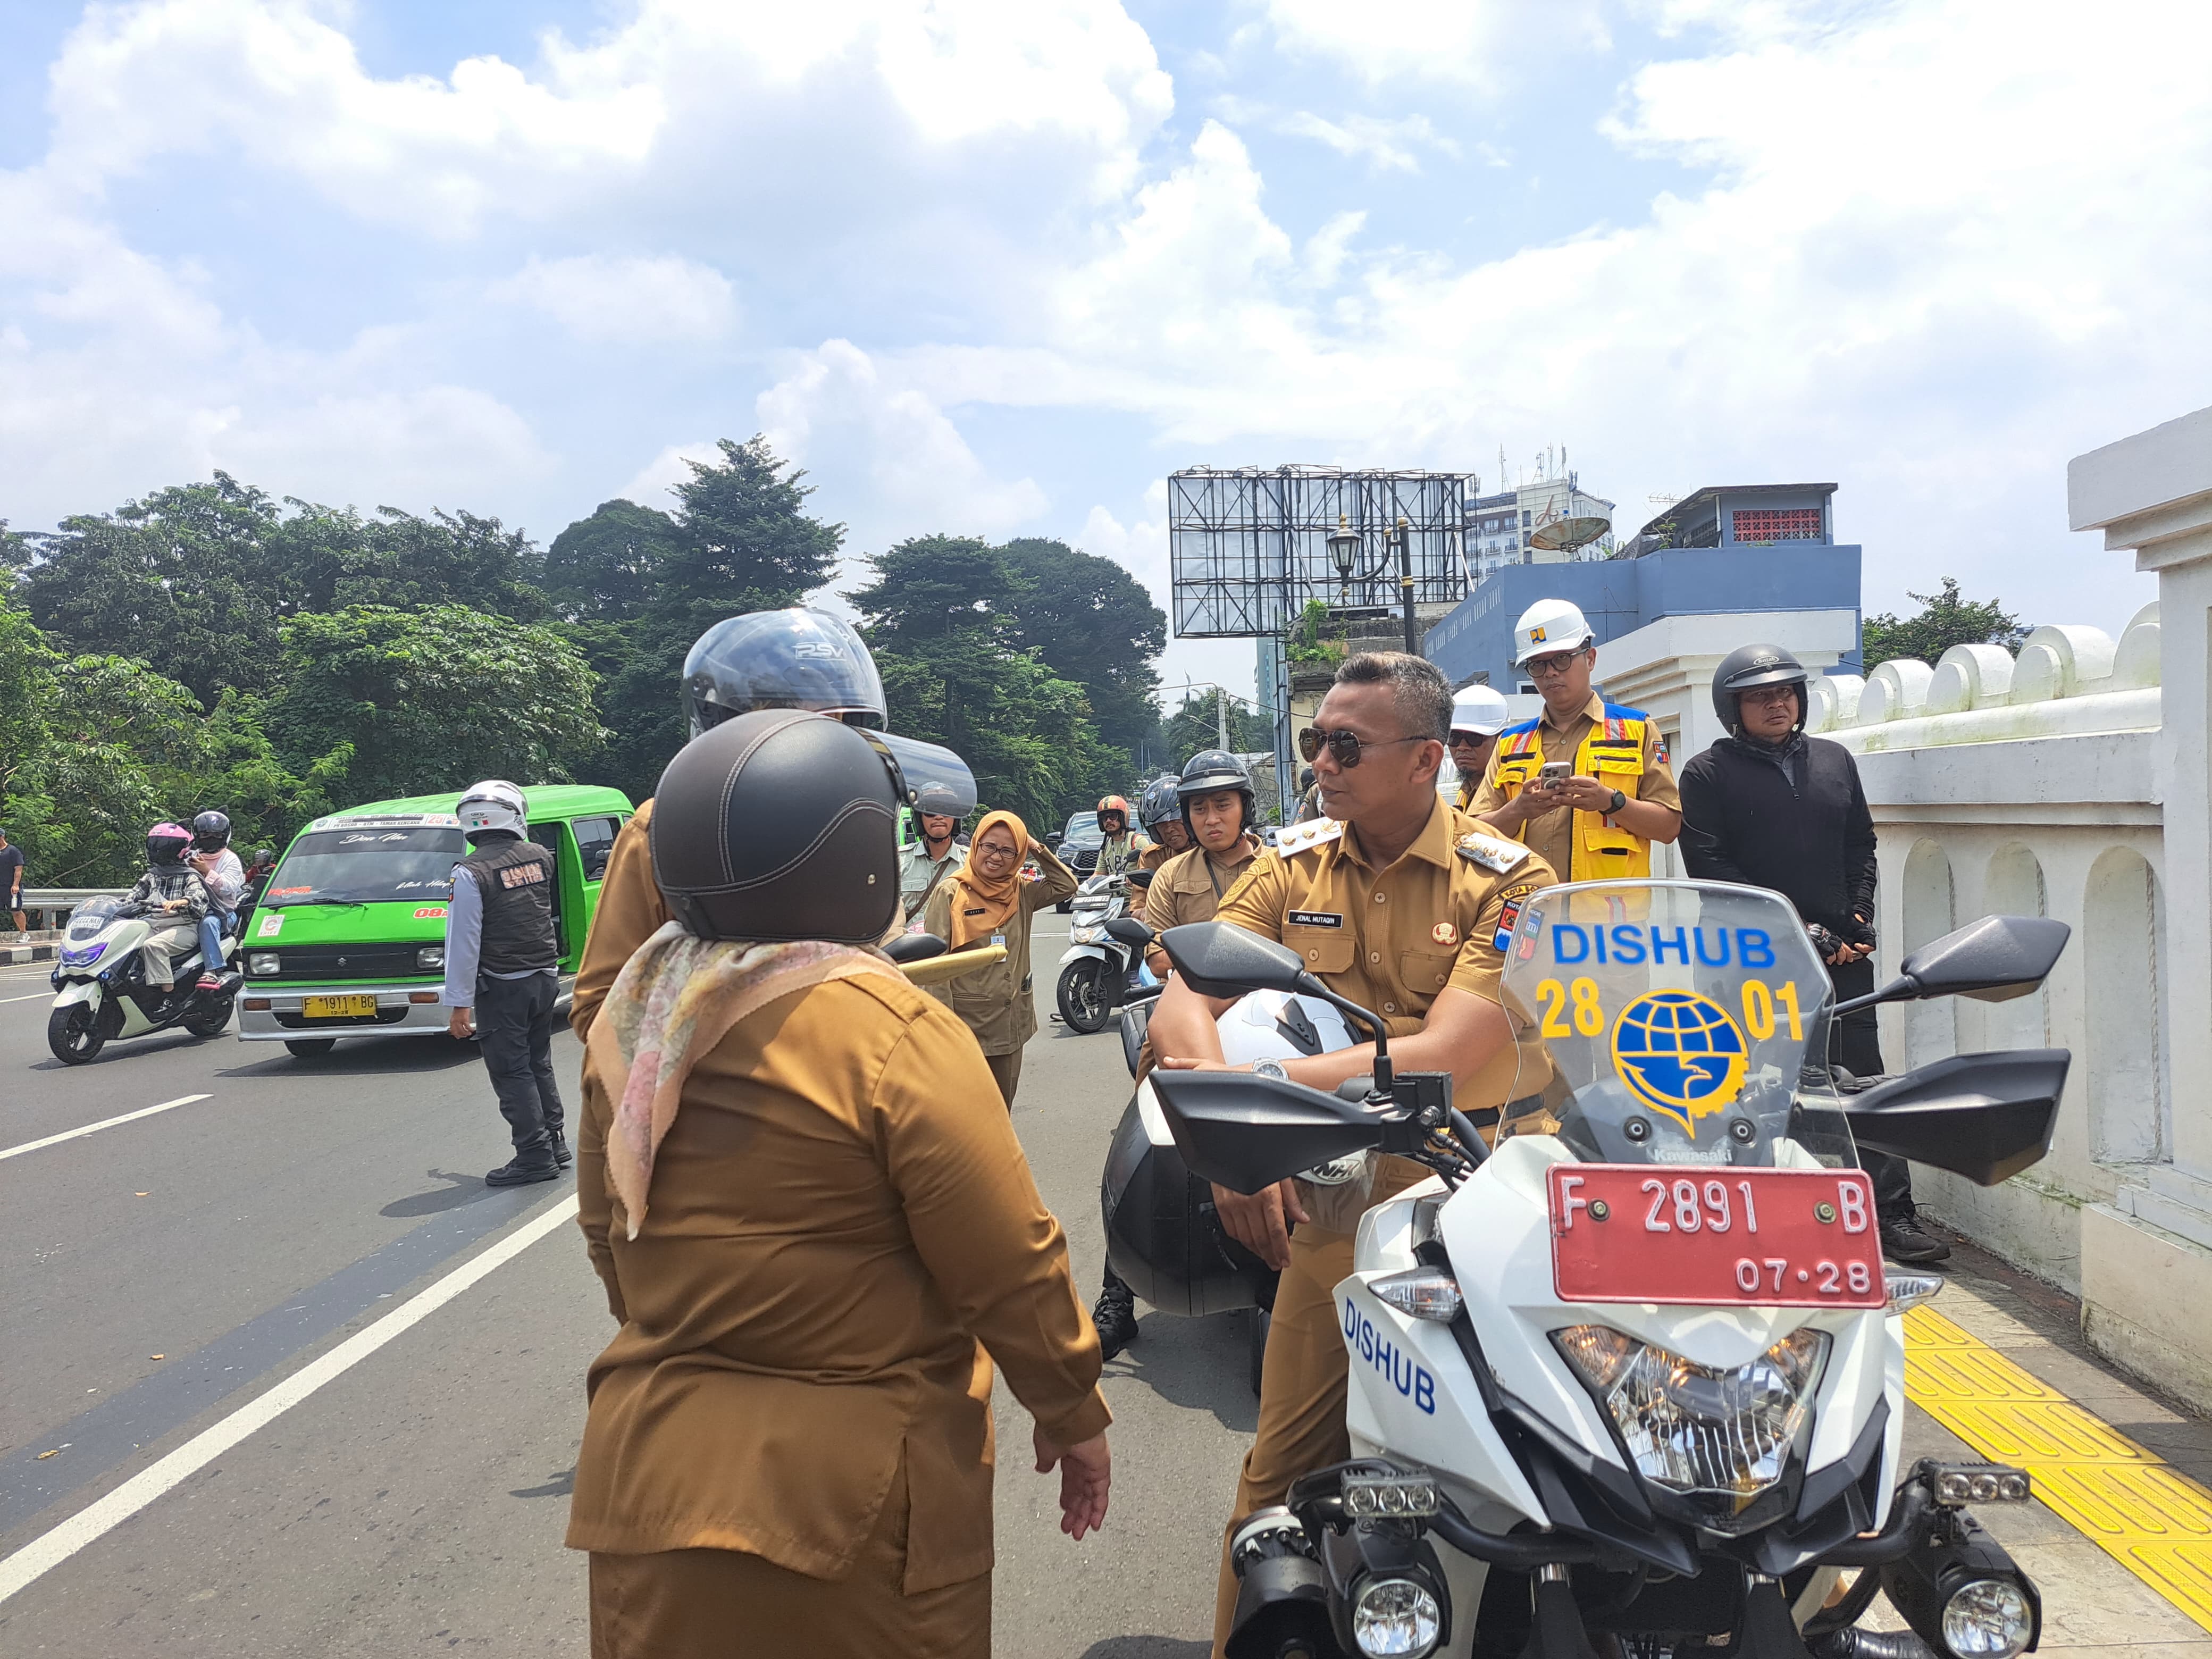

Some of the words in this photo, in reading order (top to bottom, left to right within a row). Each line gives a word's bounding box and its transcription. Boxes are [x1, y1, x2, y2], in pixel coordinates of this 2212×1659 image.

[428, 815, 443, 824] 25
[1312, 916, 1335, 924] MUTAQIN
[1530, 909, 1541, 917] GOR
[1552, 924, 1775, 969] DISHUB
[304, 998, 311, 1010] F
[324, 997, 348, 1009] 1911
[361, 996, 373, 1008] BG
[1536, 976, 1605, 1039] 28
[1741, 979, 1803, 1041] 01
[1654, 1149, 1733, 1162] Kawasaki
[1561, 1177, 1587, 1230] F
[1641, 1180, 1757, 1234] 2891
[1838, 1181, 1867, 1234] B
[1345, 1296, 1436, 1415] DISHUB
